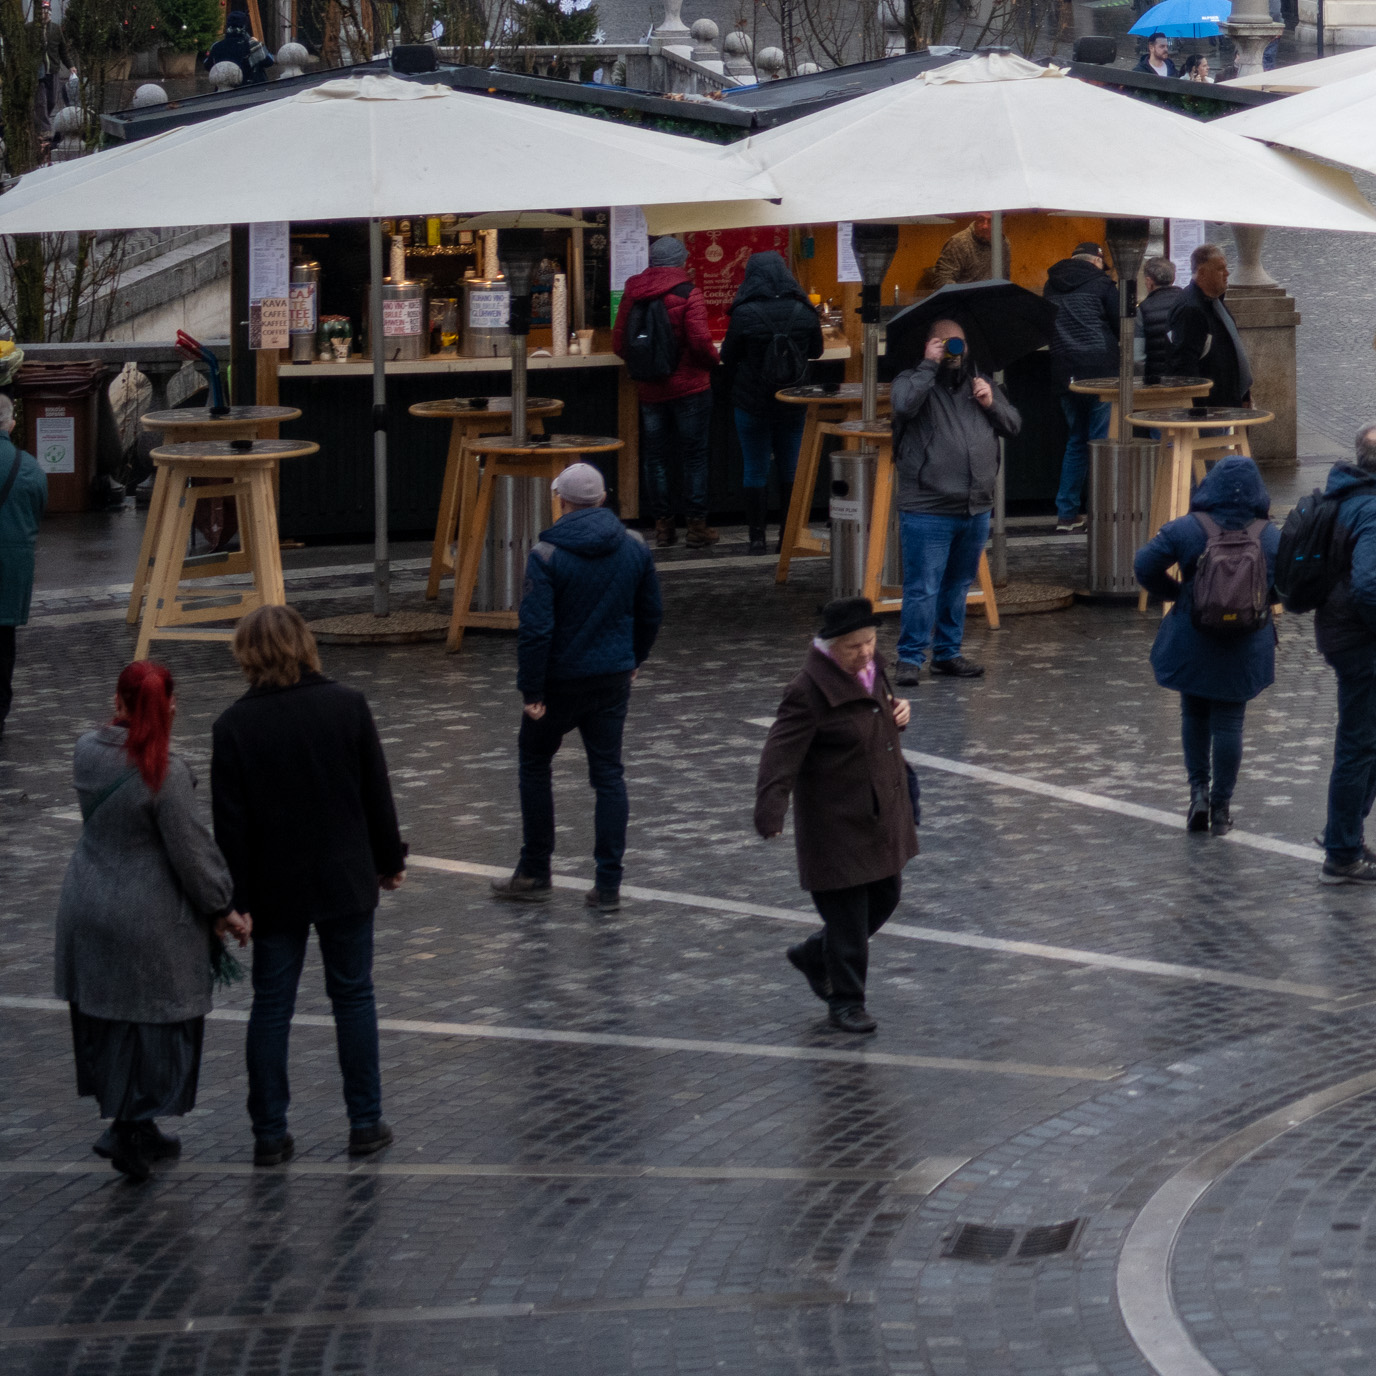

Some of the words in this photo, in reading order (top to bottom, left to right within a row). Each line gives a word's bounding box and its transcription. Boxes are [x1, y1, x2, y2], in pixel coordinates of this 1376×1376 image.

[703, 289, 737, 298] Coca-Co
[262, 300, 287, 308] KAVA
[703, 297, 733, 306] nagrad
[289, 309, 310, 319] TEE
[289, 319, 309, 329] TEA
